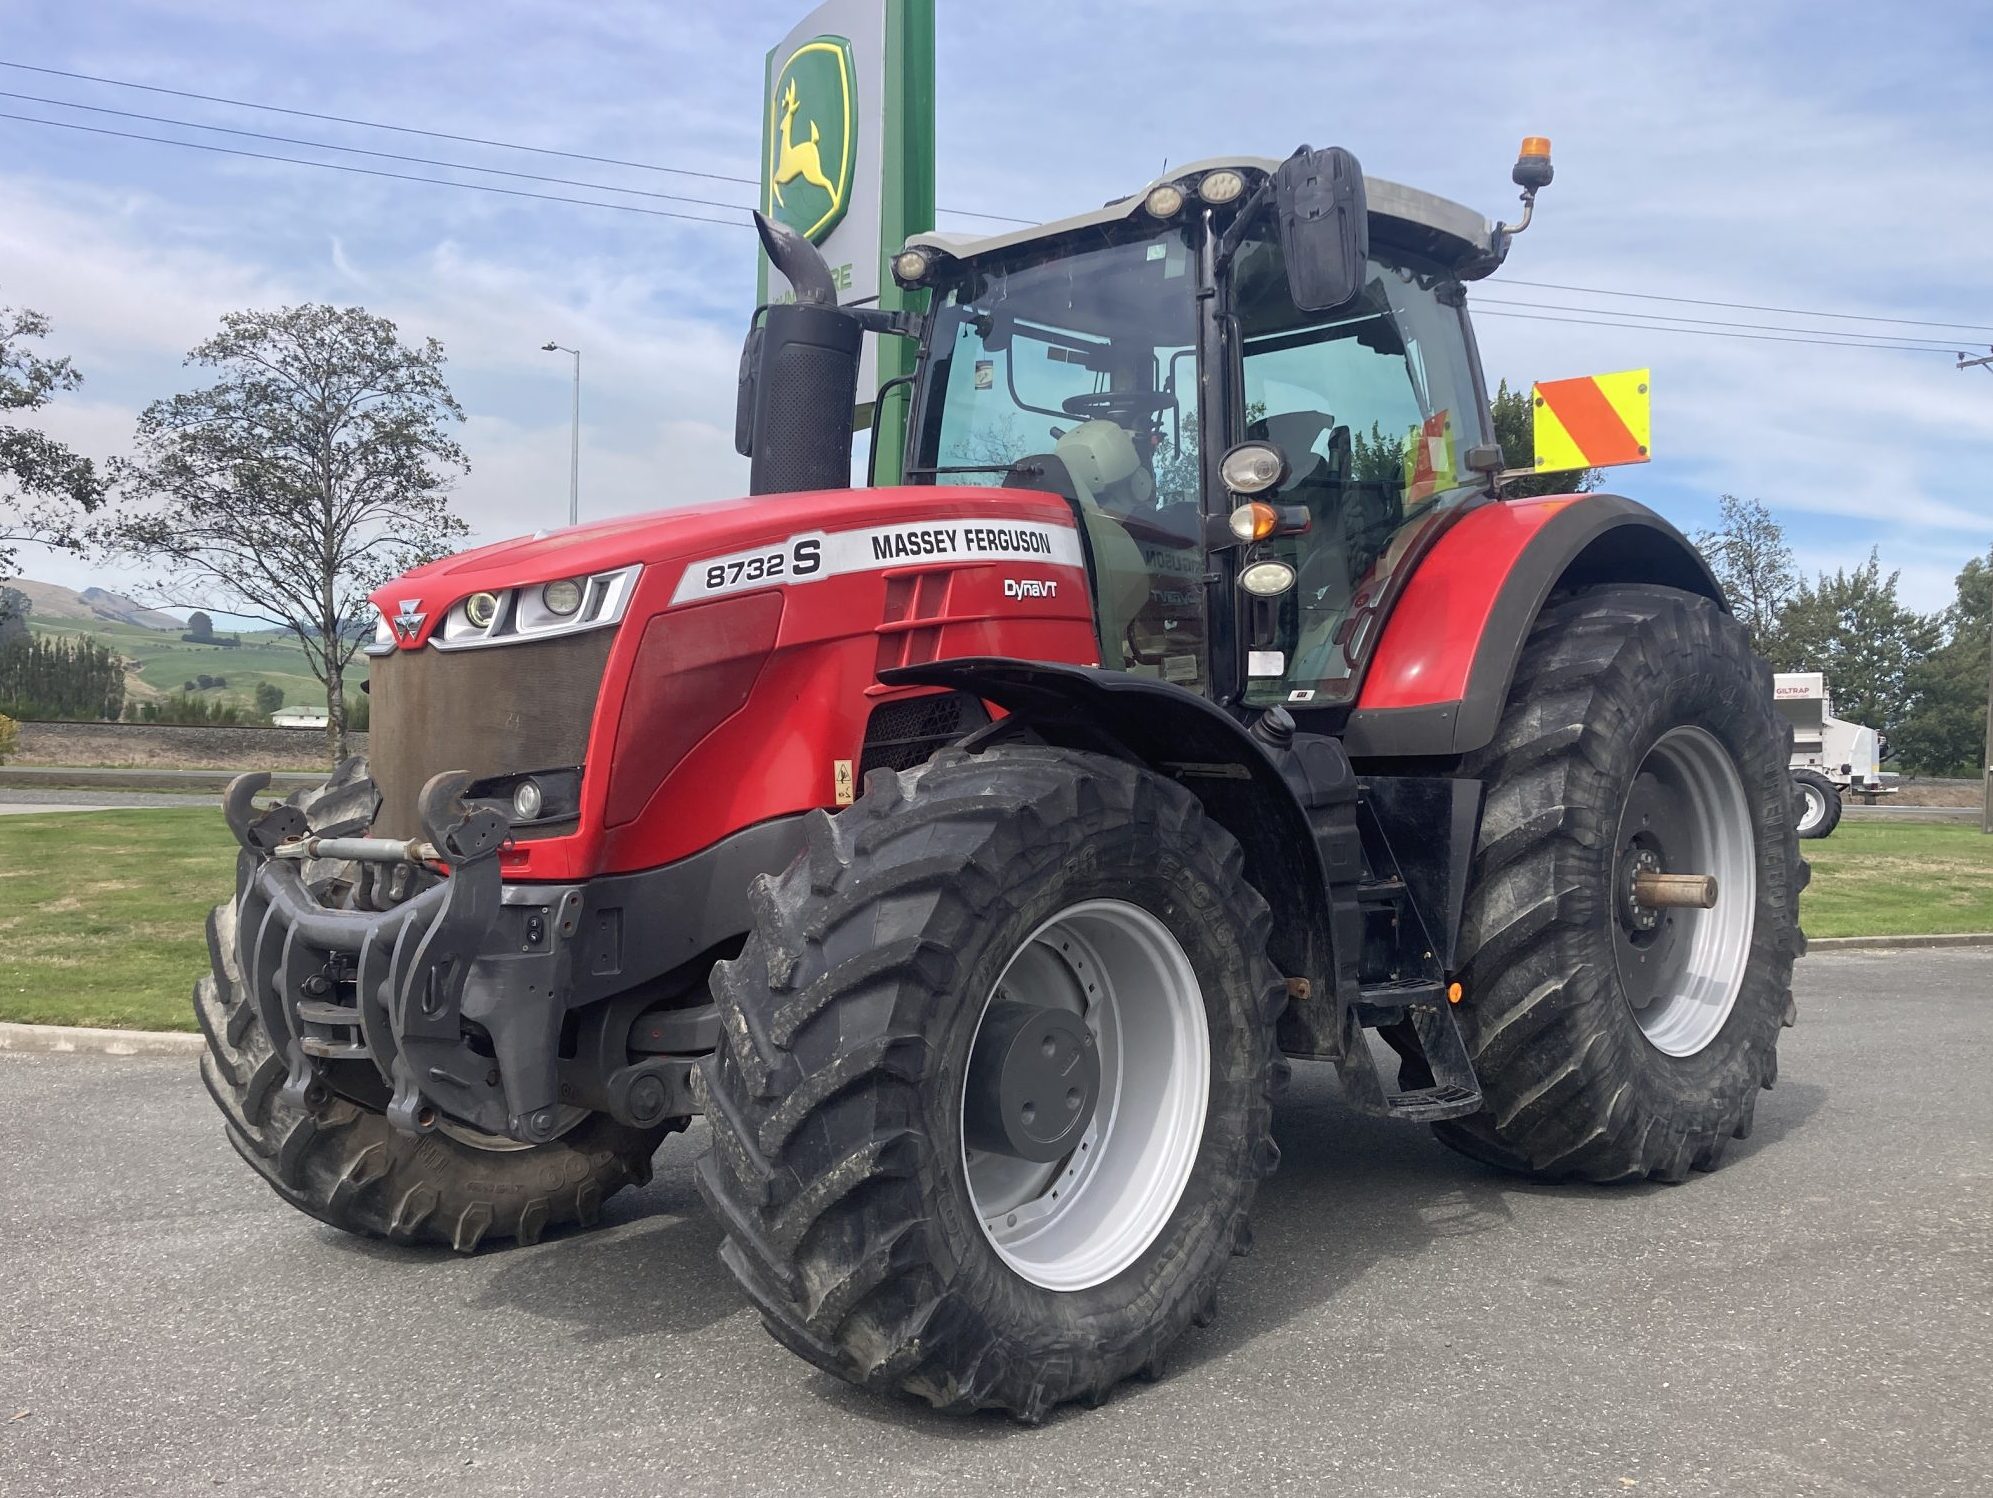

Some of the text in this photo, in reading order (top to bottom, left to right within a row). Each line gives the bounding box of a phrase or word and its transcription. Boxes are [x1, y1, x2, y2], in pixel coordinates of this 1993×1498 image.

[871, 528, 1051, 561] MASSEY FERGUSON
[706, 539, 821, 589] 8732 S
[1004, 579, 1057, 601] DynaVT
[1776, 687, 1810, 695] GILTRAP
